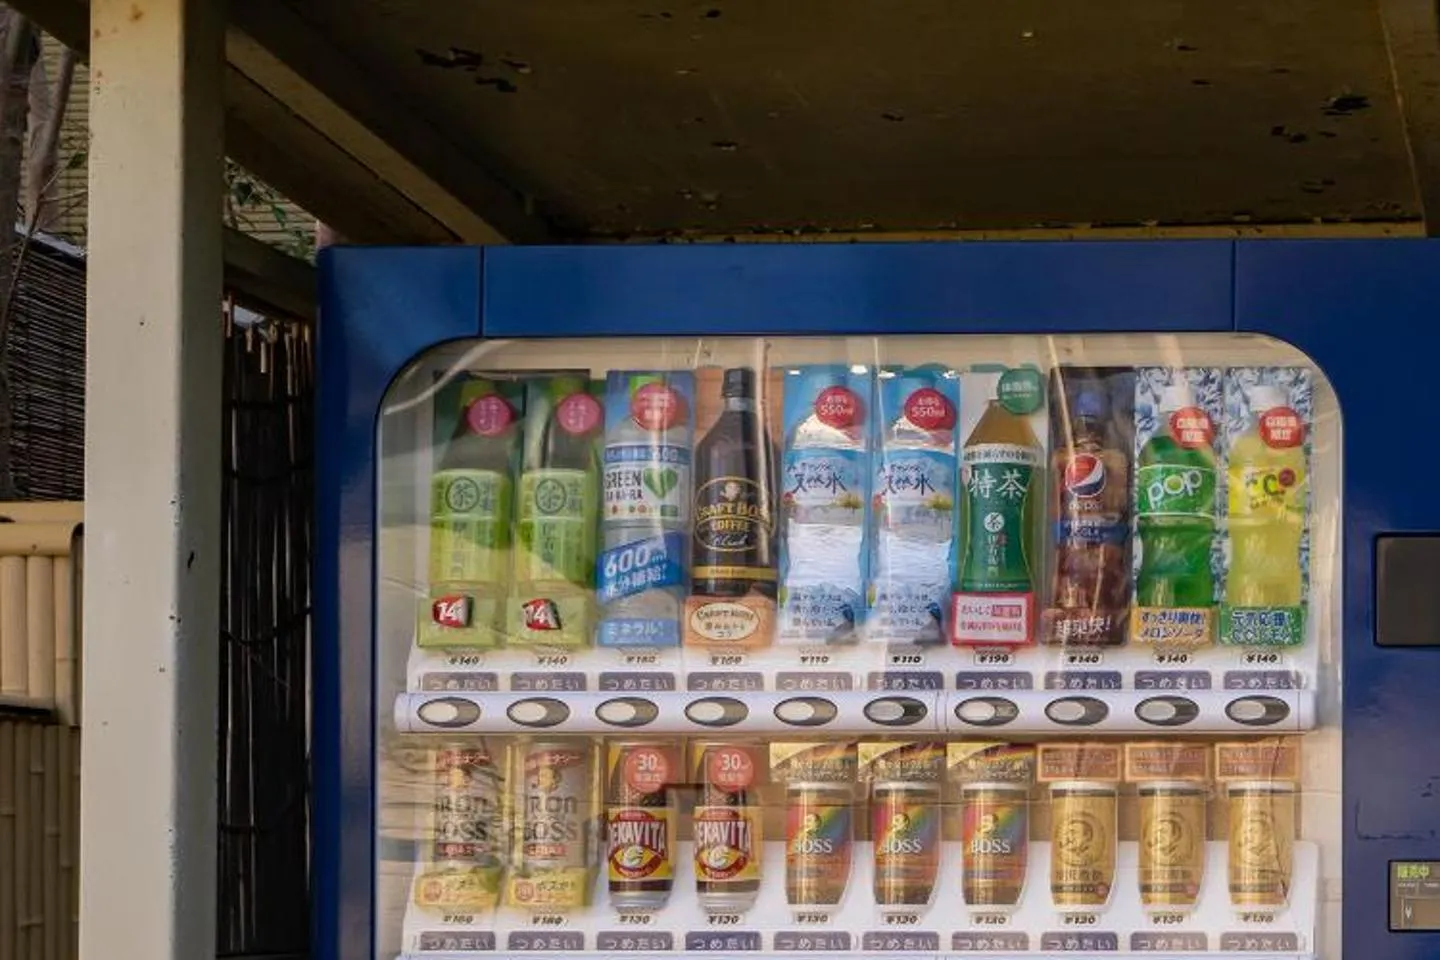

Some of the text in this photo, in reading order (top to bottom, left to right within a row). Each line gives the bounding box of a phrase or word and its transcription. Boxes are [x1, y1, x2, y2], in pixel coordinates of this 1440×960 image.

[969, 469, 1027, 499] 特茶
[637, 753, 658, 771] 30
[721, 754, 742, 771] 30
